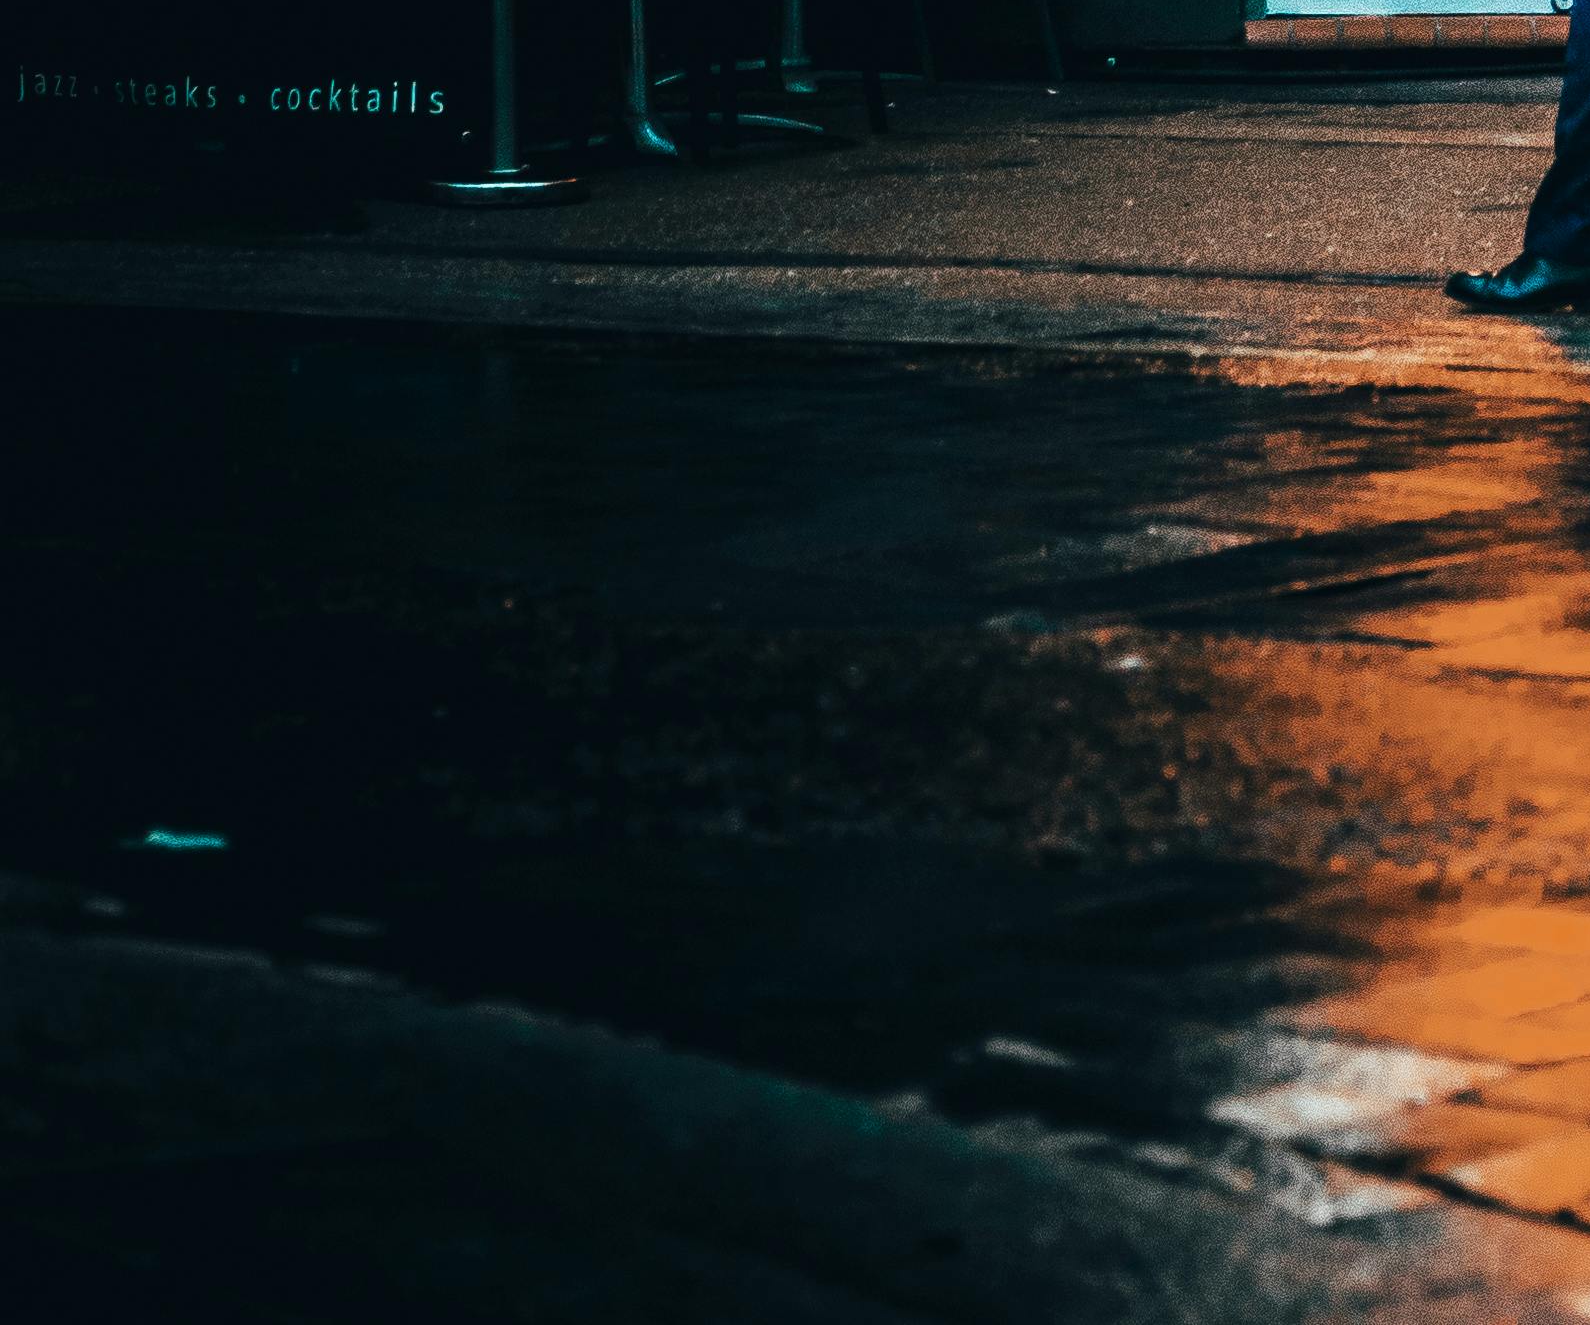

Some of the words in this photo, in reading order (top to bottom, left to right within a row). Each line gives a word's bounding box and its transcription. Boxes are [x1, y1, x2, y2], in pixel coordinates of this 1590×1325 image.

[17, 64, 81, 102] jazz
[112, 75, 218, 108] steaks
[270, 79, 446, 115] cocktails
